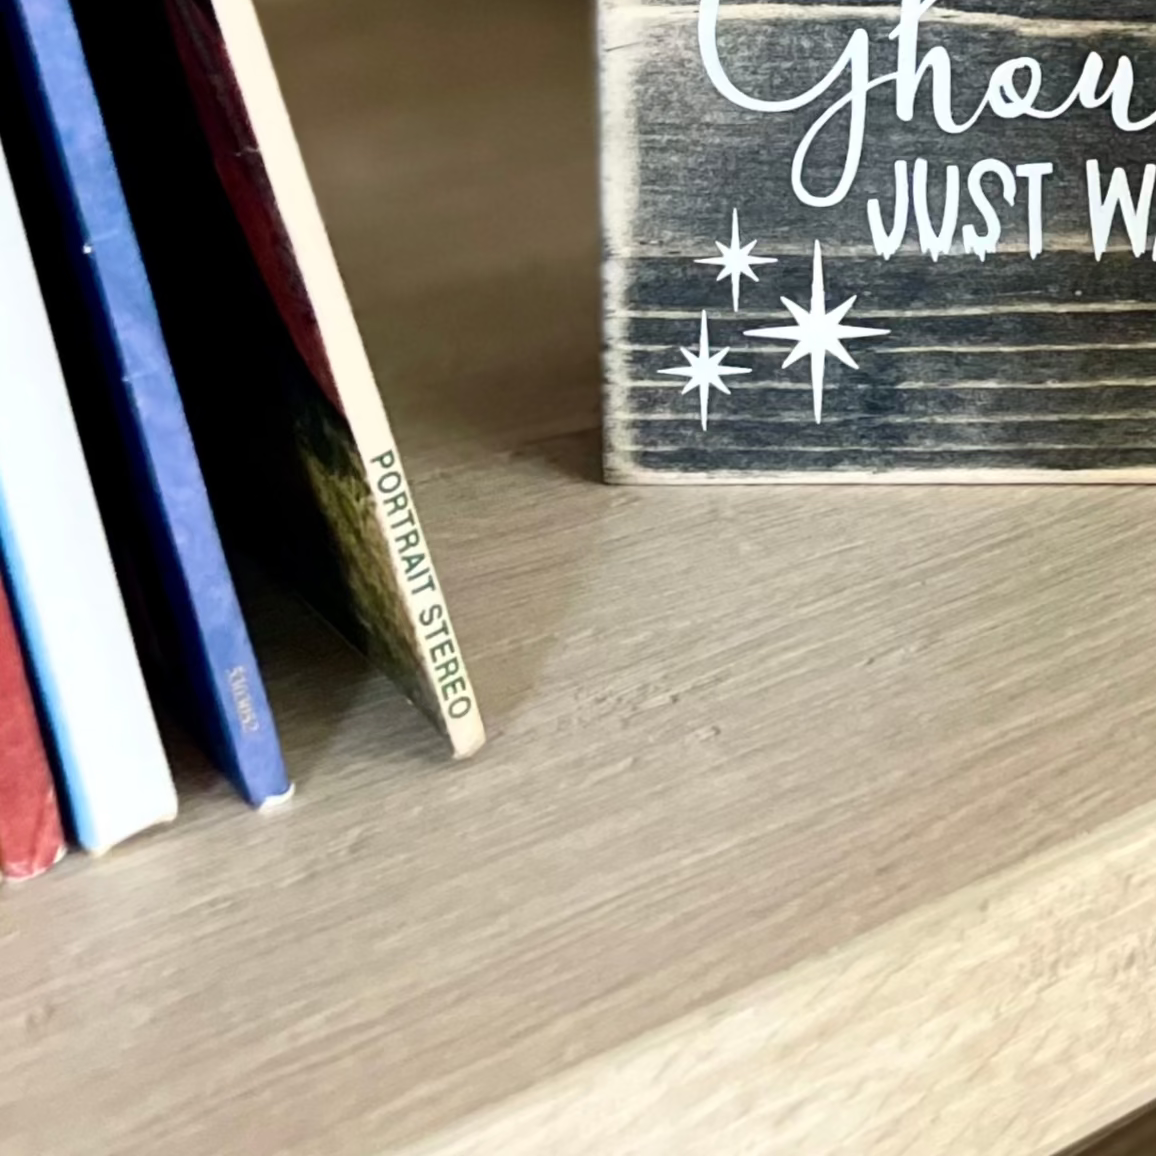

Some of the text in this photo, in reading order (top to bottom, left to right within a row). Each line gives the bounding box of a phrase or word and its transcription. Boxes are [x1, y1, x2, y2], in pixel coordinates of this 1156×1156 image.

[867, 158, 1053, 262] JUST
[371, 450, 472, 719] PORTRAIT STEREO
